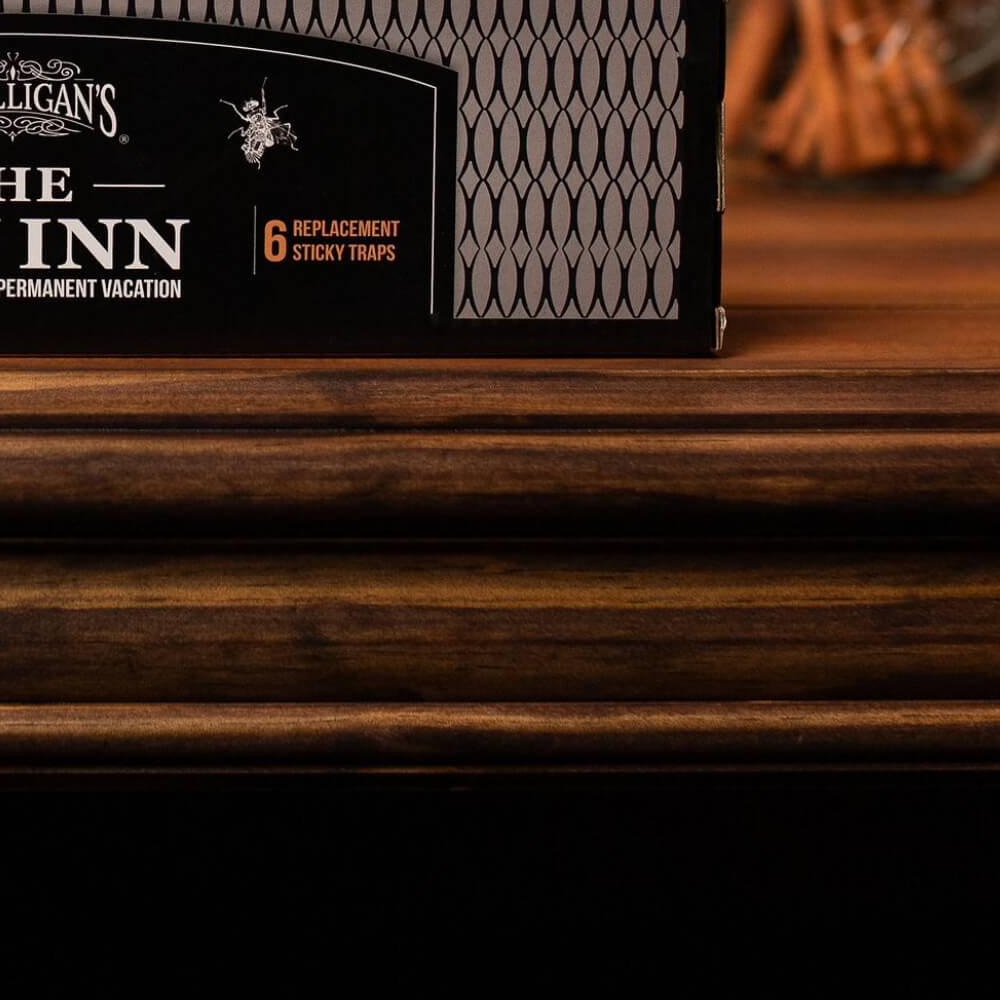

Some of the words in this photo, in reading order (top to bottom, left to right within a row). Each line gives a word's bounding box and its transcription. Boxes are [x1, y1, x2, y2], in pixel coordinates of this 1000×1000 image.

[292, 219, 401, 237] REPLACEMENT
[19, 218, 191, 270] INN
[263, 219, 288, 263] 6
[292, 244, 345, 262] STICKY
[348, 244, 396, 262] TRAPS
[101, 279, 182, 299] VACATION
